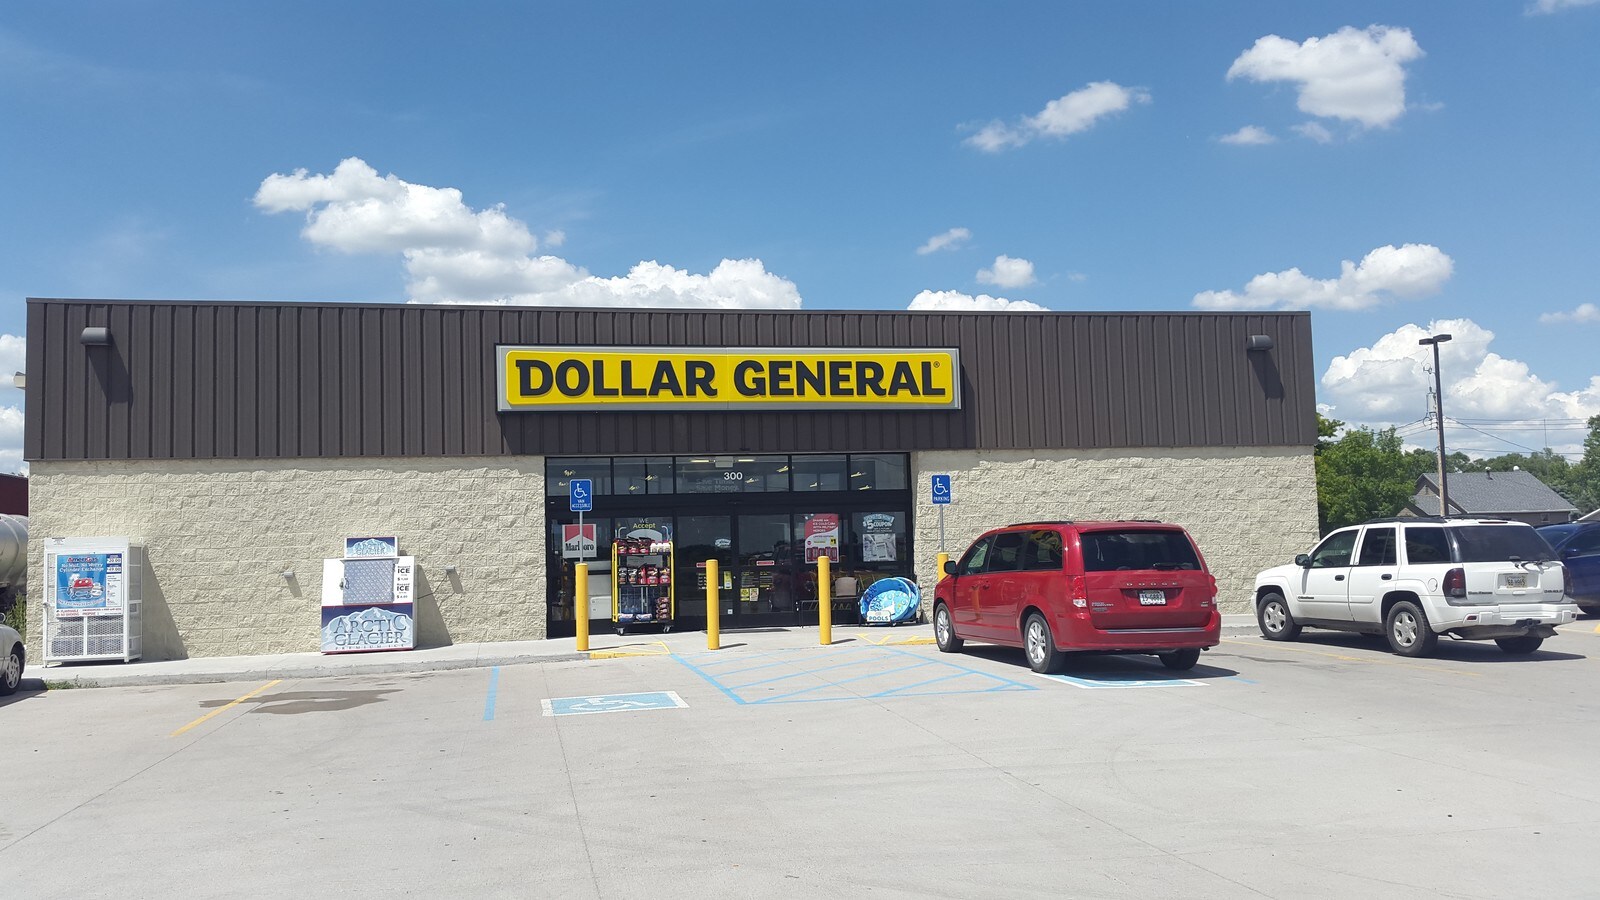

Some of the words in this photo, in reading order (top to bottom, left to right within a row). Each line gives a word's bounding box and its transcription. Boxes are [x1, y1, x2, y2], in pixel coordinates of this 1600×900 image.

[515, 359, 718, 397] DOLLAR
[733, 360, 946, 397] GENERAL
[723, 471, 743, 480] 300
[565, 540, 595, 551] Marloro
[334, 615, 407, 633] ARCTIC
[334, 631, 407, 646] GLACIER
